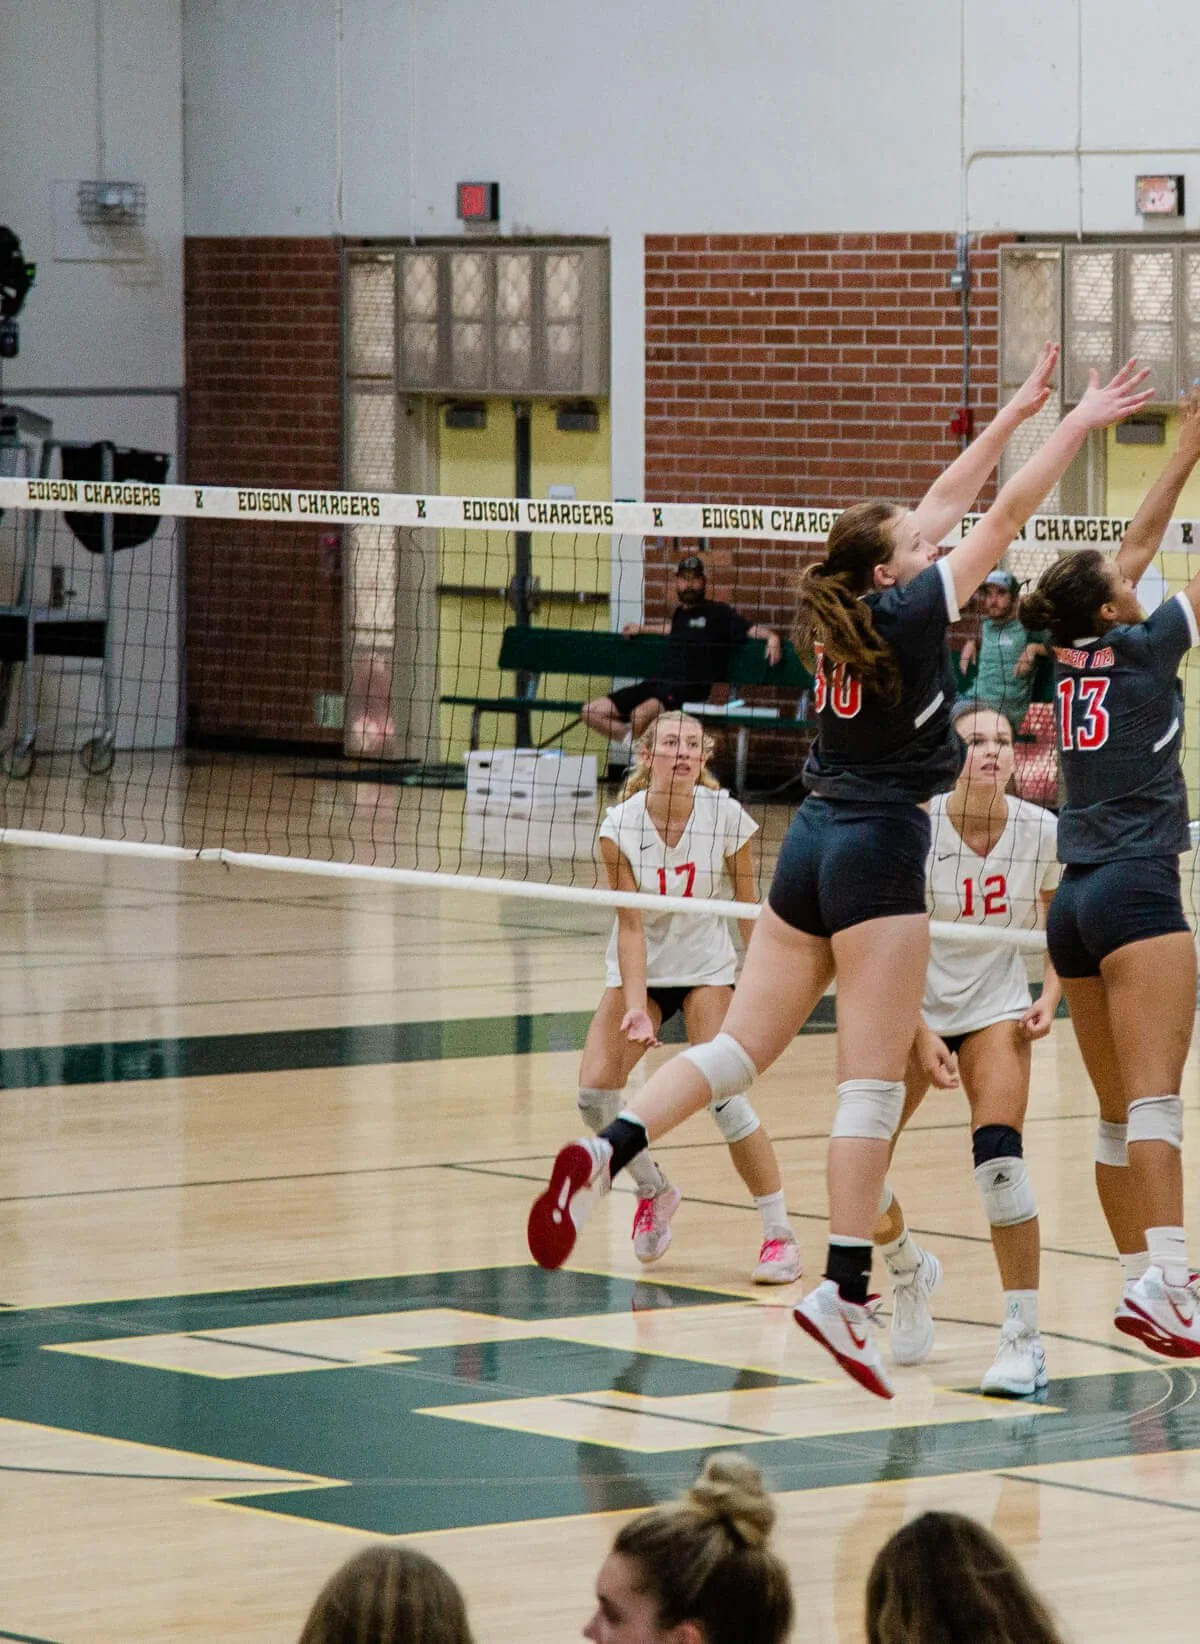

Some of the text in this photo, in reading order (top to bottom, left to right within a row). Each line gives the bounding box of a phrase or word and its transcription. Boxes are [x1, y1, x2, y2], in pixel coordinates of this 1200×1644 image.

[27, 481, 78, 502] EDISON
[84, 485, 161, 507] CHARGERS
[237, 491, 293, 513] EDISON
[298, 494, 381, 517] CHARGERS
[462, 500, 519, 523] EDISON
[527, 503, 614, 526] CHARGERS
[702, 508, 764, 530] EDISON
[770, 511, 838, 534] CHARG
[1057, 677, 1111, 751] 13
[657, 861, 696, 898] 17
[962, 874, 1007, 917] 12
